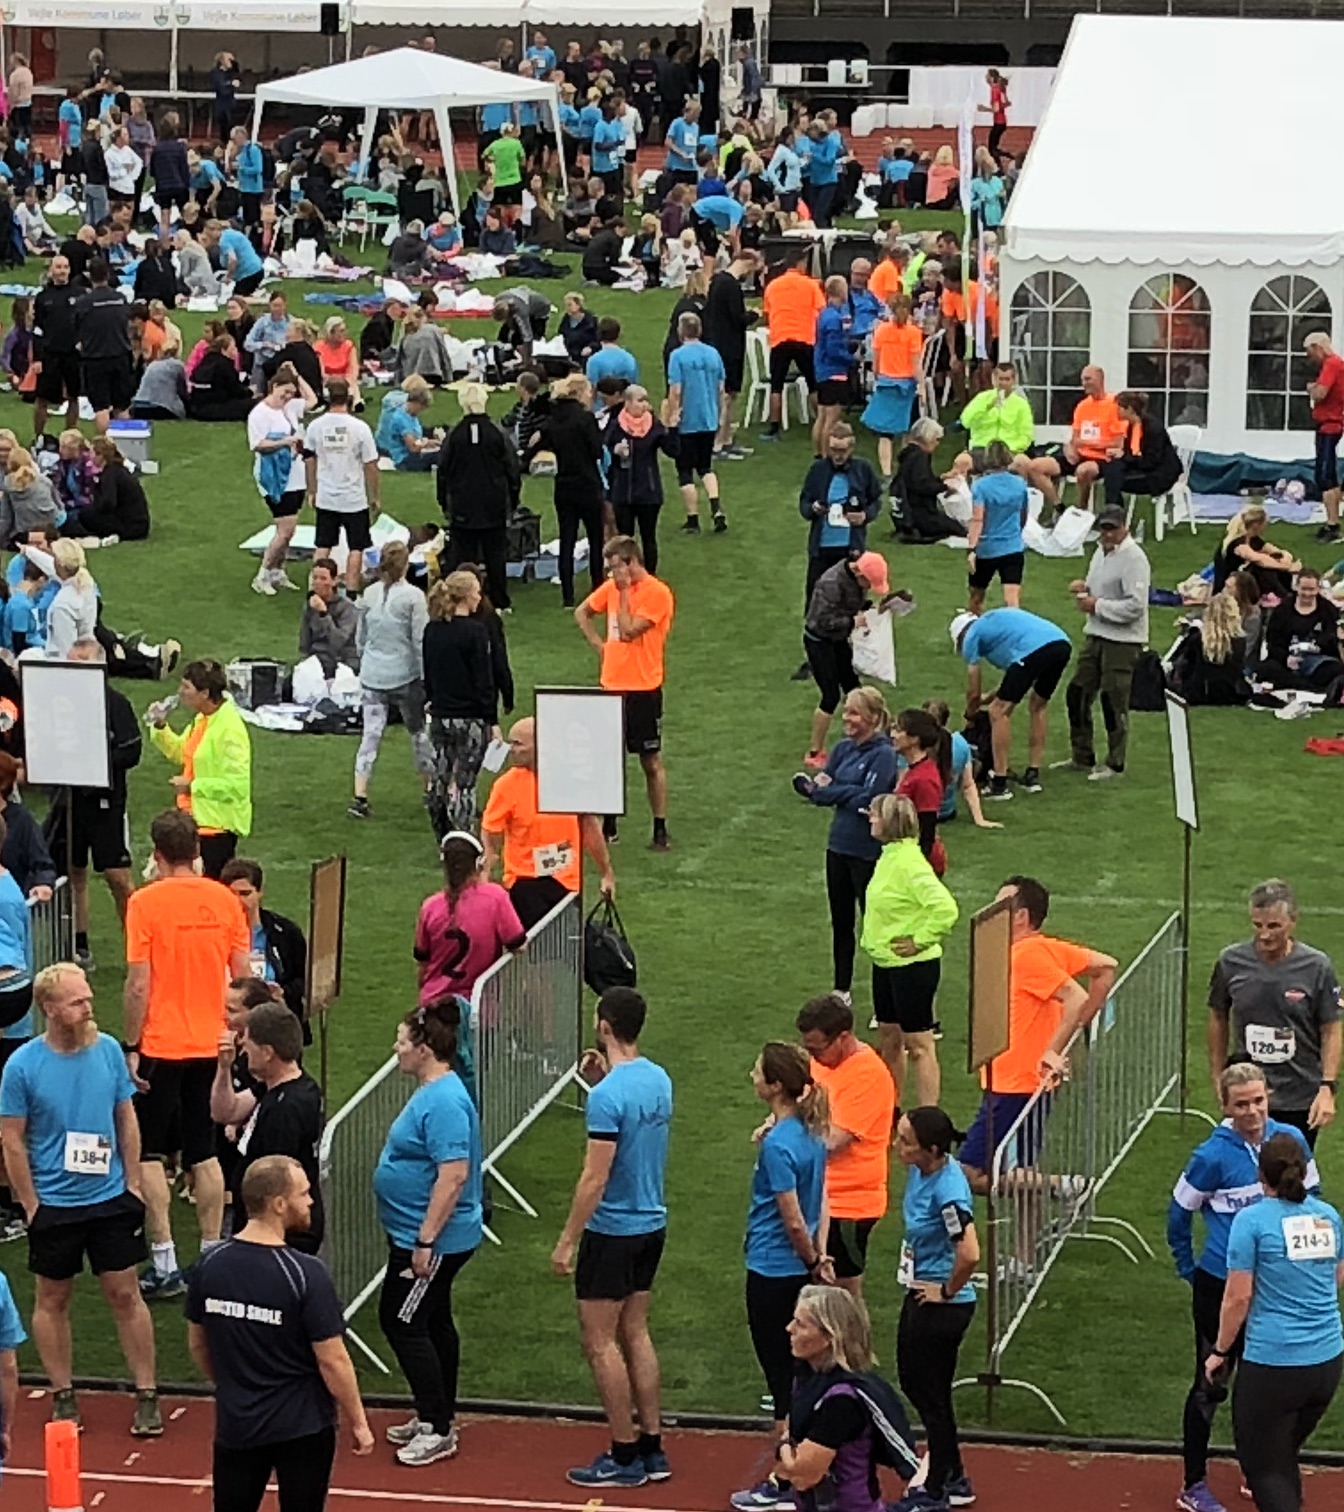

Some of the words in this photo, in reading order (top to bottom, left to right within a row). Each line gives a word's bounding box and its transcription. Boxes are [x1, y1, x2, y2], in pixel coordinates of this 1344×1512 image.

[440, 926, 471, 980] 2
[1250, 1040, 1290, 1055] 120-4
[71, 1149, 109, 1165] 138-4
[1291, 1233, 1332, 1249] 214-3
